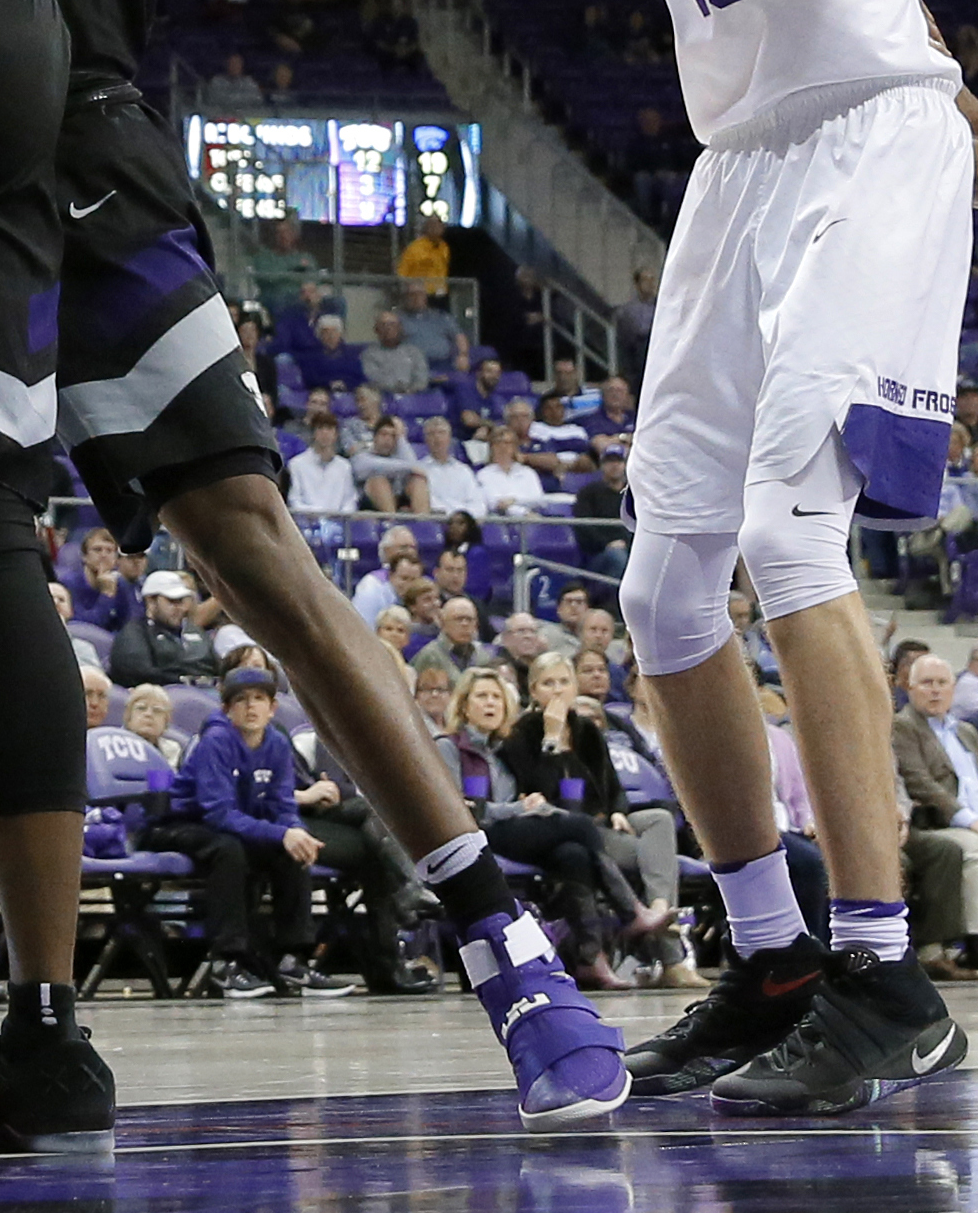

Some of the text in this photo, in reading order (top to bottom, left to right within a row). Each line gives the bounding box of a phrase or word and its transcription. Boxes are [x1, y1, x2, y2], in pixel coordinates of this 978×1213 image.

[353, 150, 382, 173] 12
[359, 174, 441, 198] 3 7
[538, 575, 550, 598] 2
[98, 734, 148, 762] TCU
